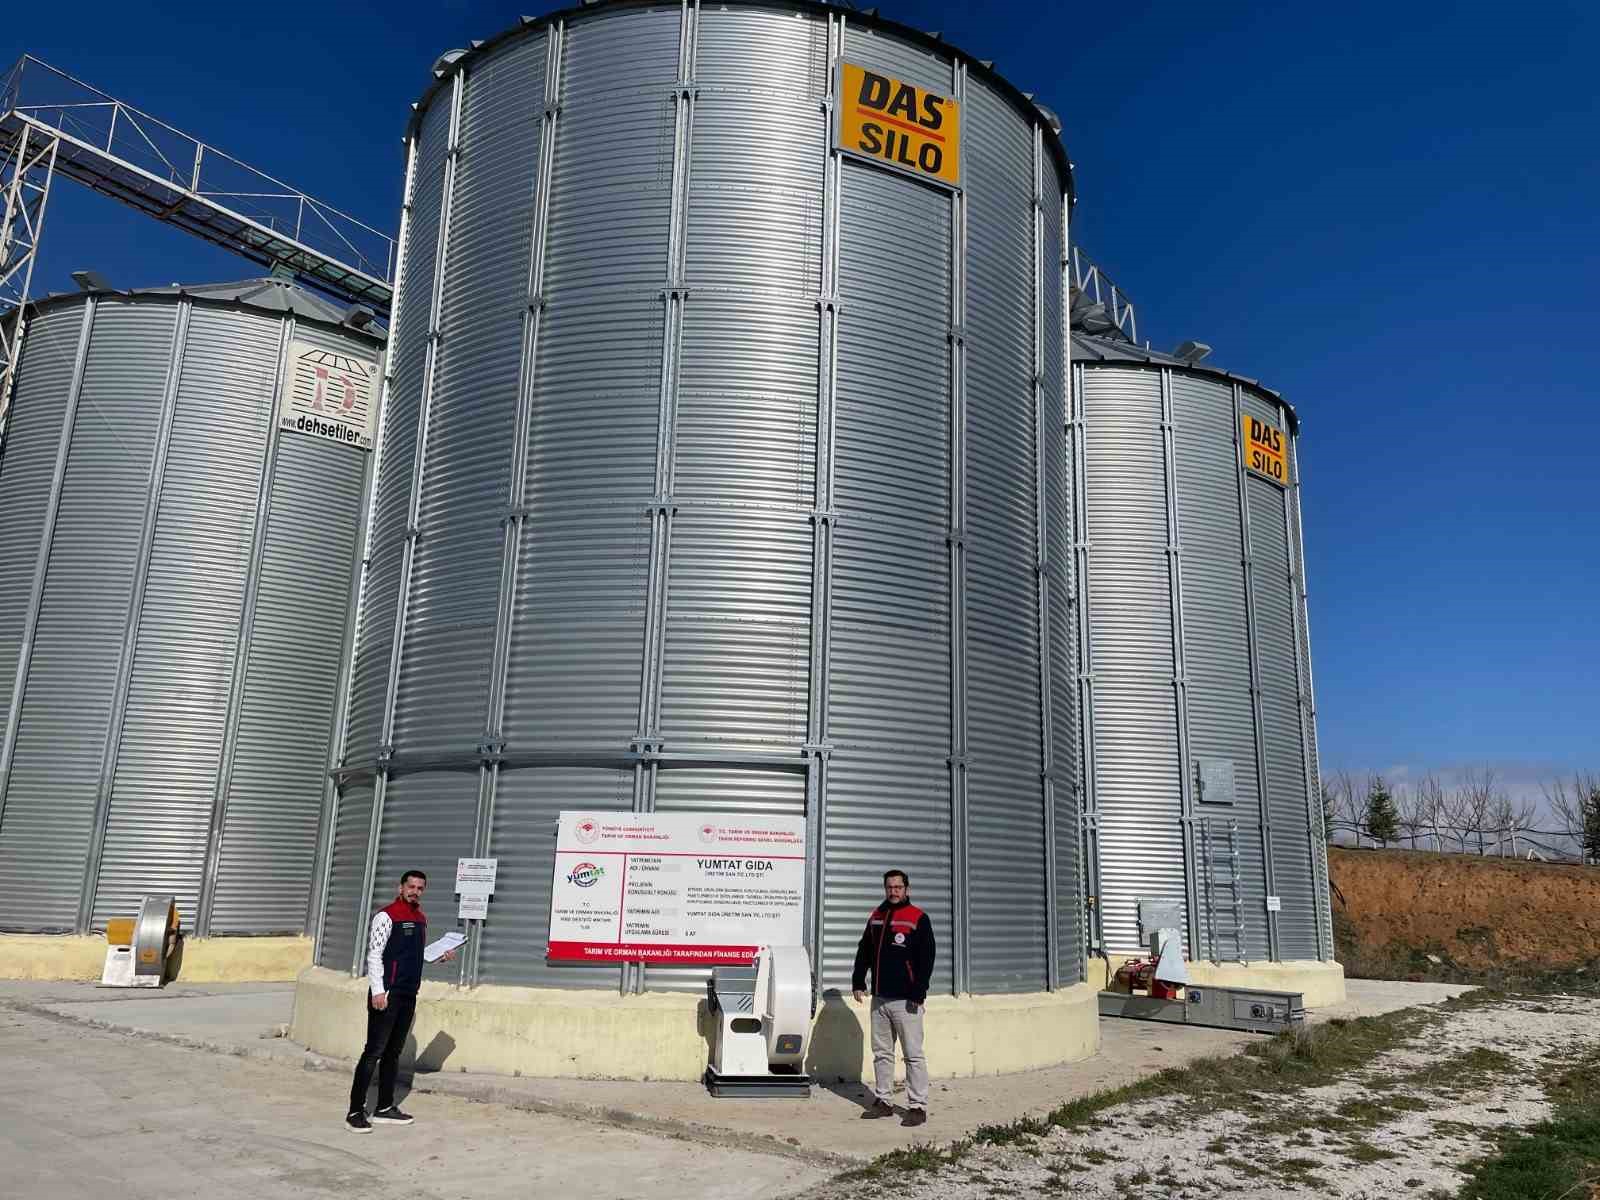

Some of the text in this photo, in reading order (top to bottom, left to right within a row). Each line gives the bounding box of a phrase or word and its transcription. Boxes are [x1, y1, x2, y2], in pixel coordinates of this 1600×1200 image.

[859, 71, 944, 130] DAS
[859, 122, 943, 174] SILO
[1250, 417, 1281, 452] DAS
[1252, 450, 1283, 479] SILO
[566, 867, 605, 884] yumtat
[697, 859, 773, 871] YUMTAT GIDA
[584, 947, 603, 955] TARIM
[613, 948, 637, 956] ORMAN
[639, 948, 672, 957] BAKANLIĞI
[714, 950, 741, 958] FİNANSE
